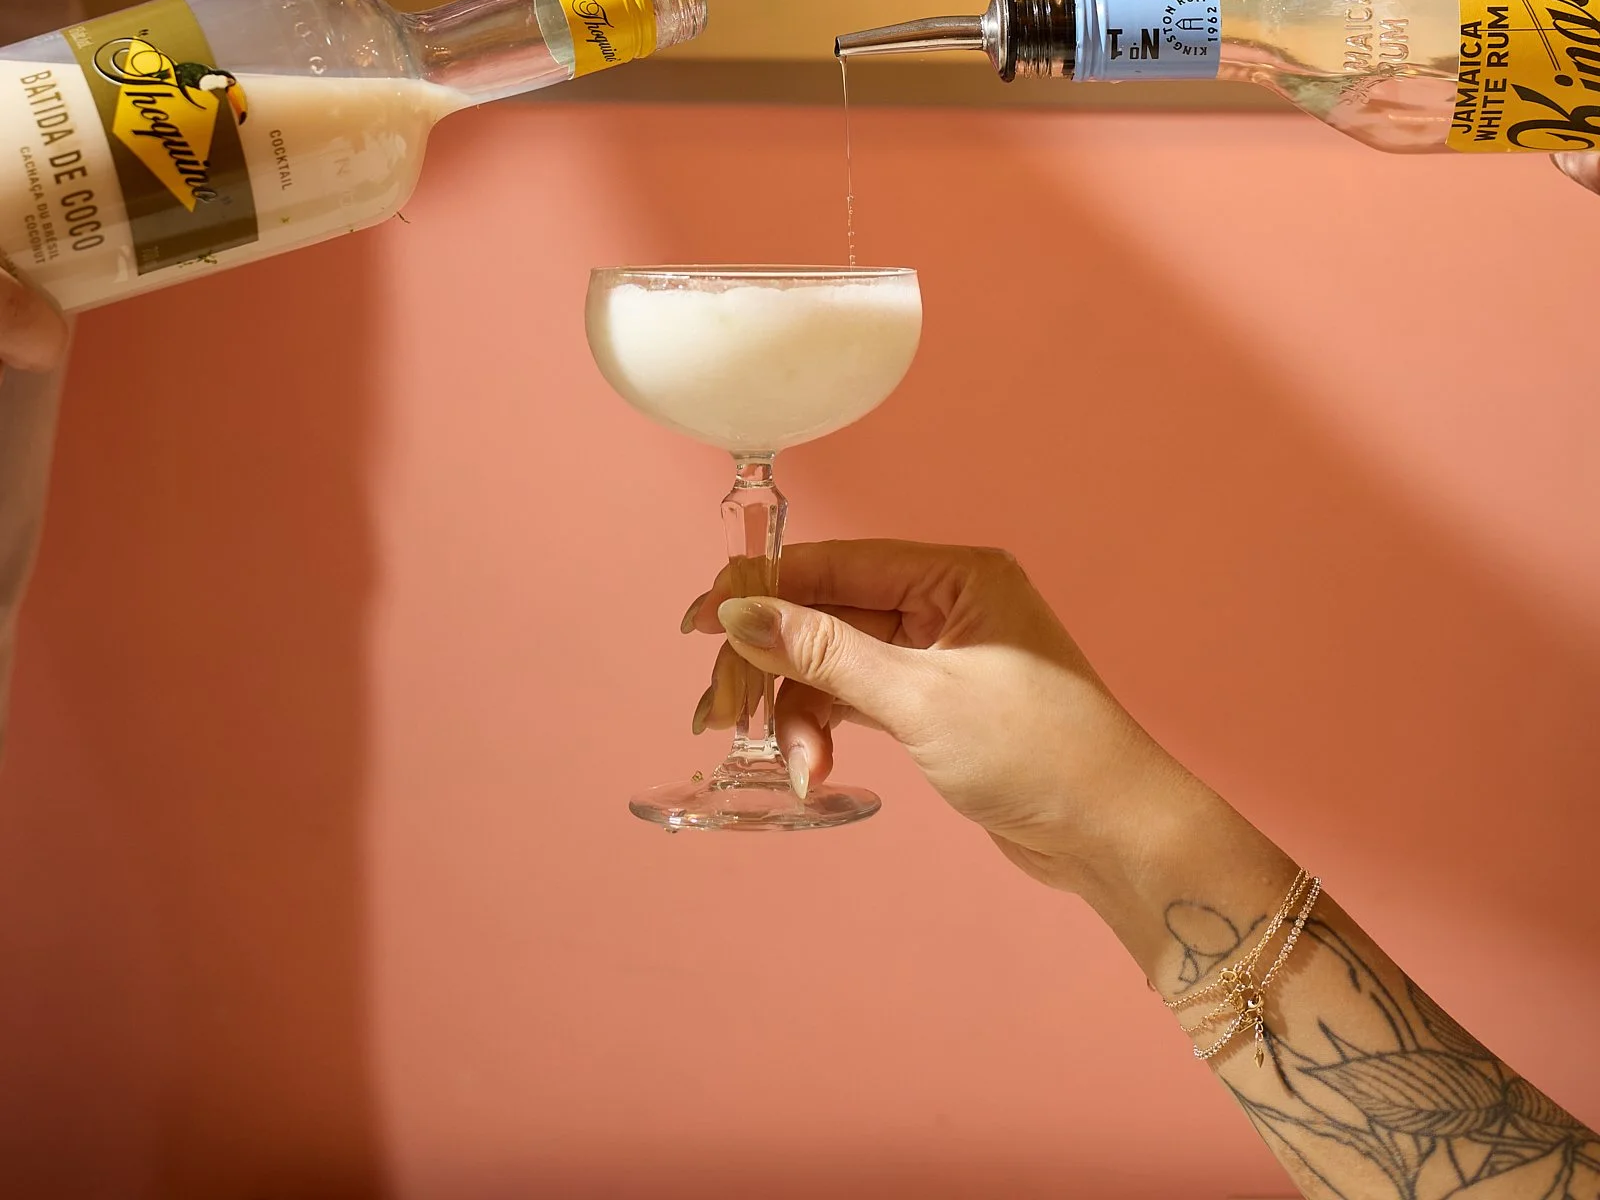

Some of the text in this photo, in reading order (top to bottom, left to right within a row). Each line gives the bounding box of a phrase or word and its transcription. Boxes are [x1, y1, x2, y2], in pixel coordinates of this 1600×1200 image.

[1106, 28, 1123, 60] 1
[1162, 5, 1208, 56] KINGSTON
[1206, 6, 1218, 42] 1962
[1452, 20, 1482, 135] JAMAICA
[1473, 5, 1510, 142] WHITE RUM
[19, 145, 46, 201] CACHAÇA
[36, 201, 52, 223] DU
[20, 69, 105, 253] BATIDA DE COCO
[269, 128, 294, 191] COCKTAIL
[23, 213, 46, 265] COCONUT
